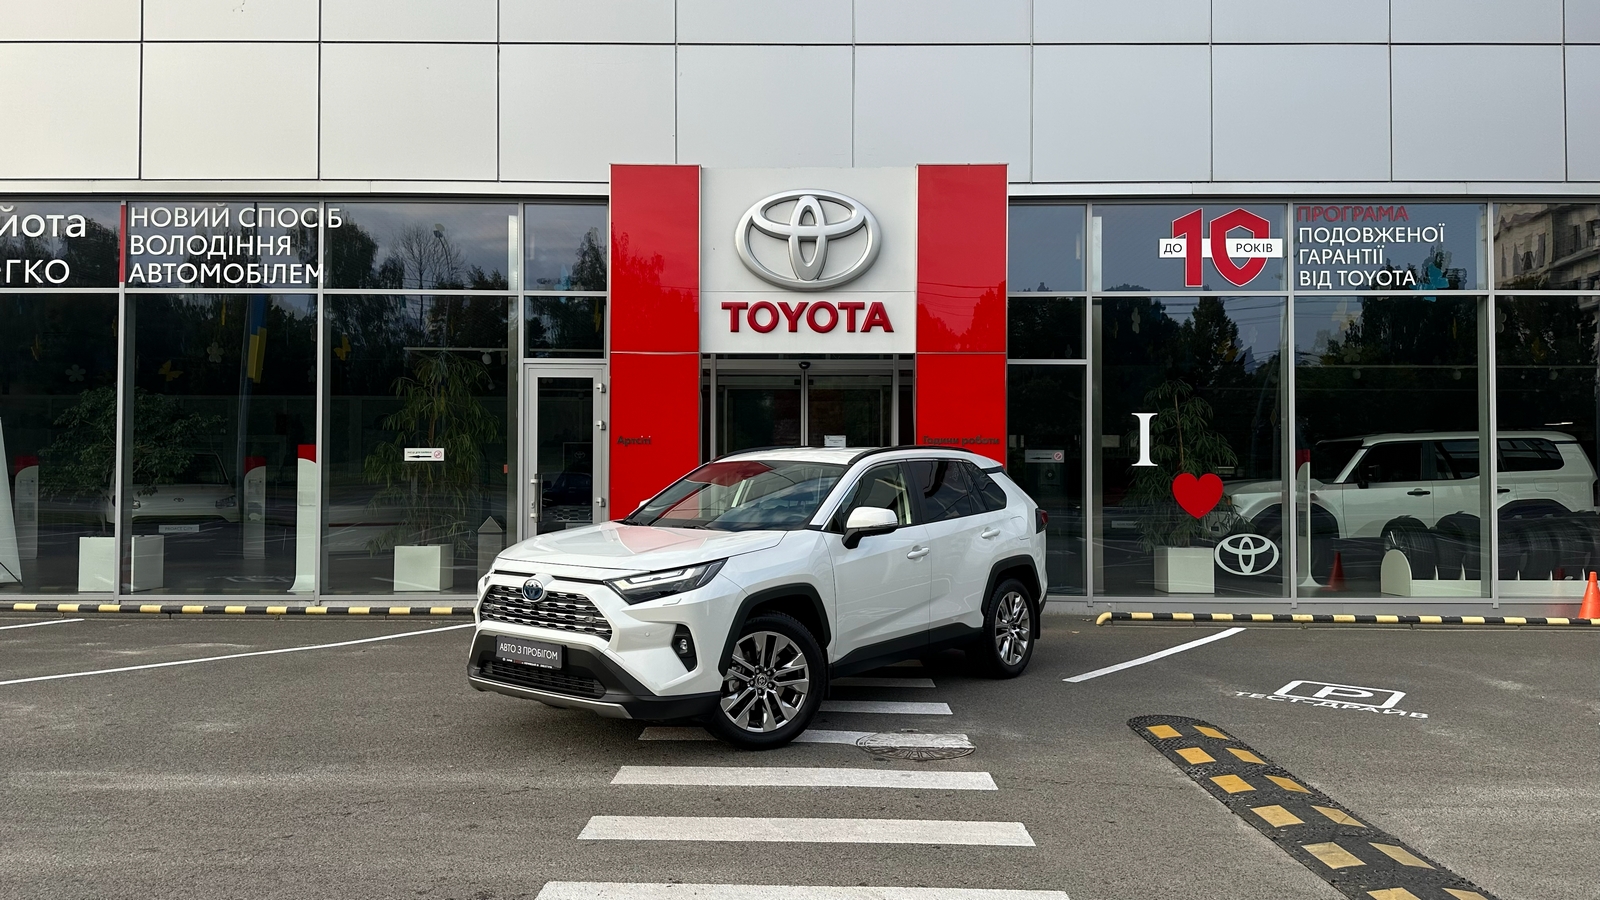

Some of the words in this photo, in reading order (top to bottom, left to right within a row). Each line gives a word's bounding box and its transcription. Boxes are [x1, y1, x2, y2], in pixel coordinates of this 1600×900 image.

[0, 205, 86, 238] йота
[131, 203, 230, 228] НОВИЙ
[238, 207, 343, 228] СПОСІБ
[1297, 205, 1409, 222] ПРОГРАМА
[1299, 223, 1446, 246] ПОДОВЖЕНОЇ
[131, 234, 291, 260] ВОЛОДІННЯ
[1164, 243, 1183, 255] ДО
[1172, 208, 1270, 287] 10
[1236, 243, 1273, 253] РОКІВ
[1299, 247, 1384, 265] ГАРАНТІЇ
[0, 259, 70, 284] ГКО
[128, 263, 324, 284] АВТОМОБІЛЕМ
[1299, 271, 1333, 289] ВІД
[1339, 270, 1417, 287] TOYOTA
[721, 301, 894, 334] TOYOTA
[1131, 412, 1158, 467] I
[499, 642, 517, 653] АВТО
[522, 646, 558, 660] ПРОБІГОМ
